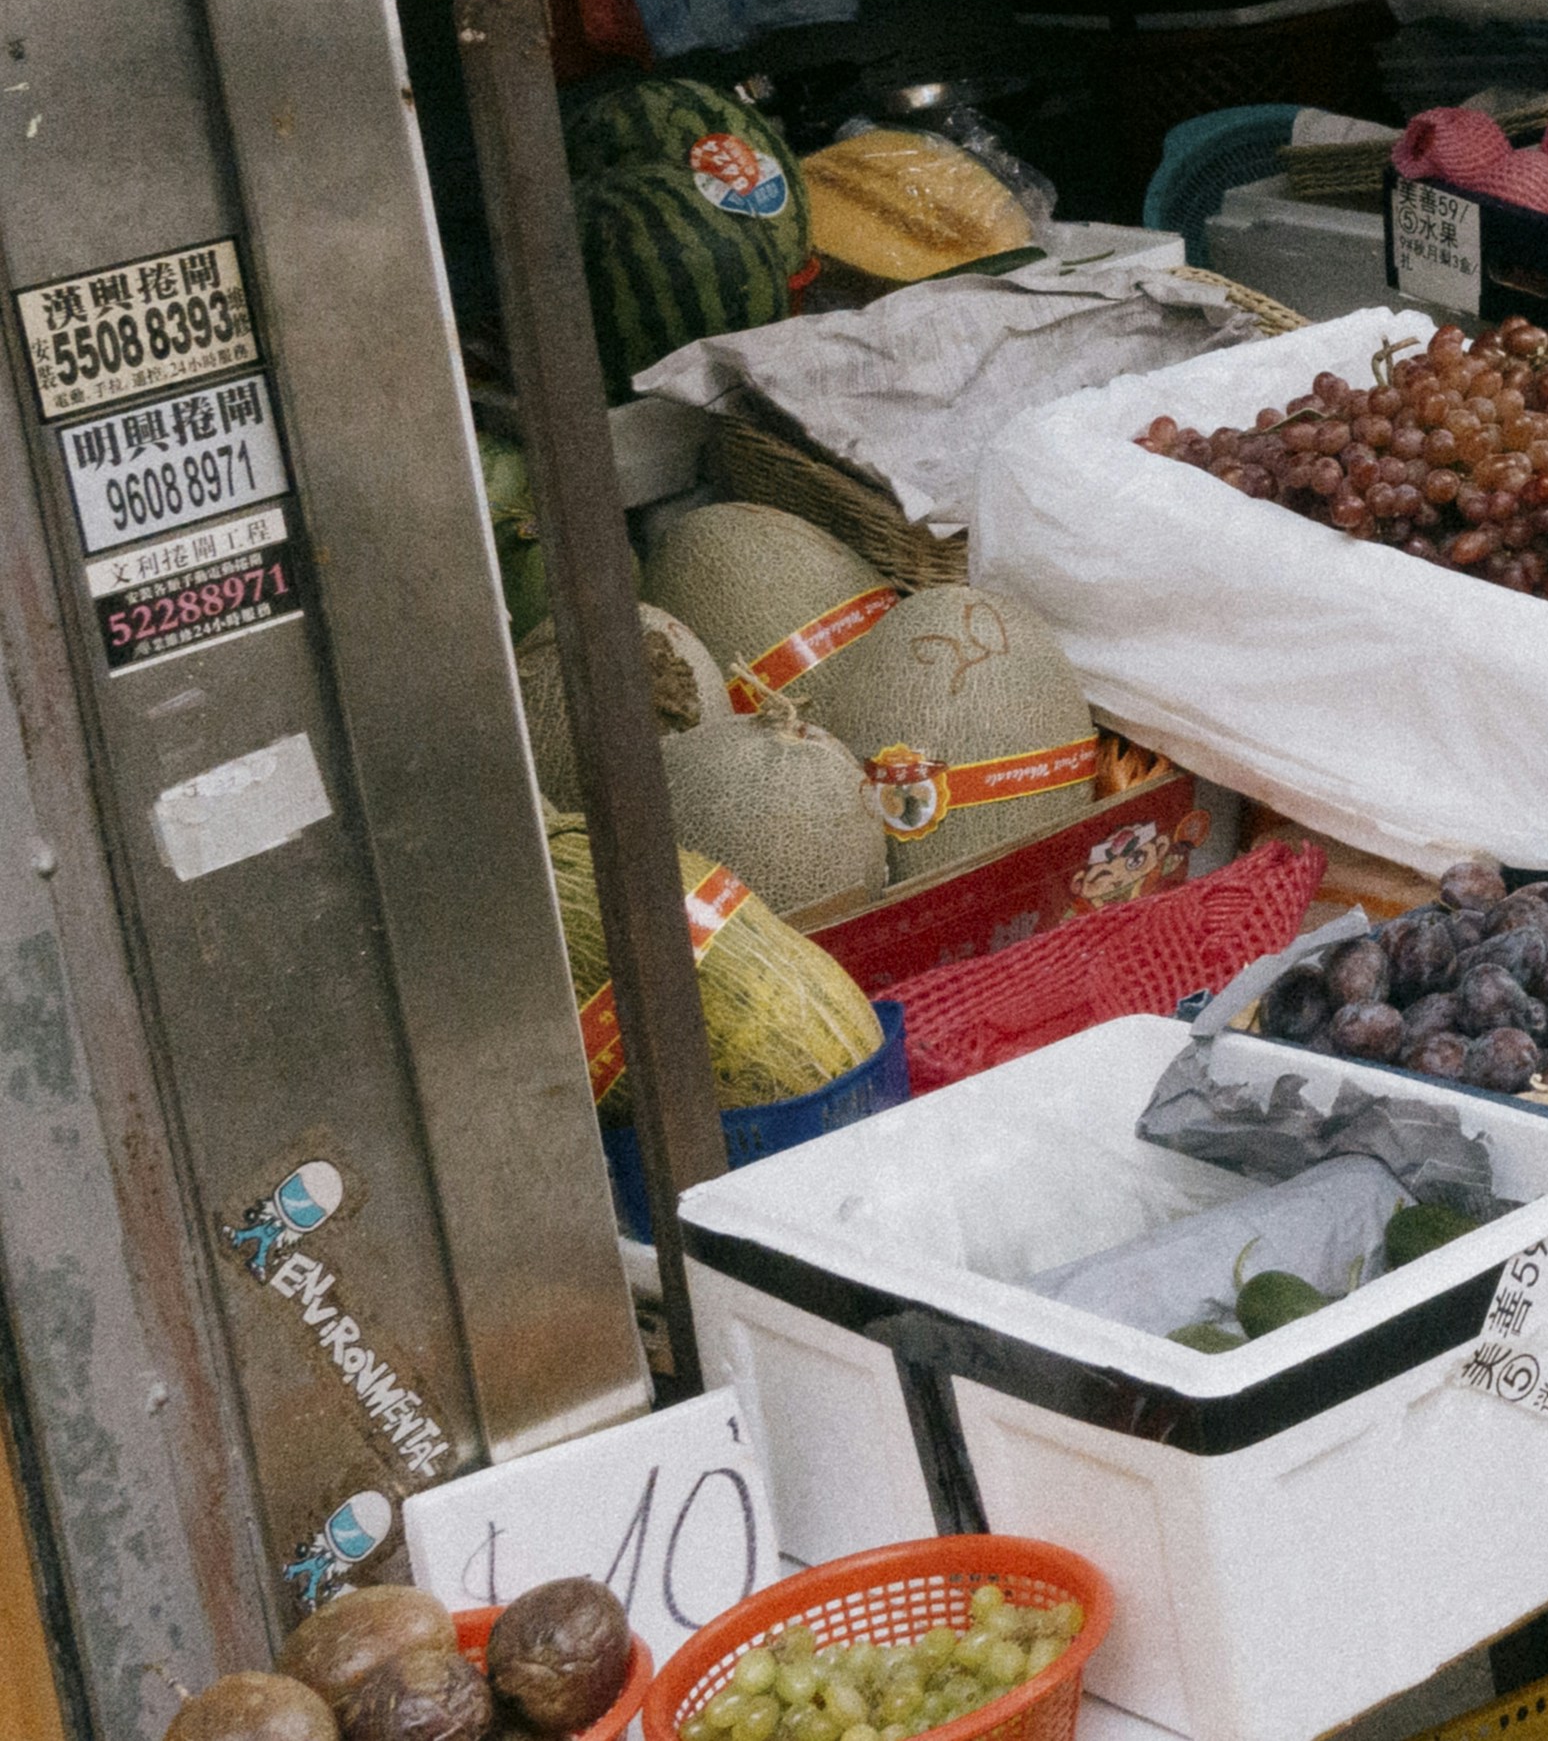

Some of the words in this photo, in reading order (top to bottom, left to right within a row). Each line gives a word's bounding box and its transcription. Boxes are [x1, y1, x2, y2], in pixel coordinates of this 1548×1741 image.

[42, 249, 220, 330] 漢興捲閘
[54, 311, 144, 386] 5508
[149, 289, 229, 361] 8393
[73, 380, 264, 472] 明興捲閘
[106, 475, 183, 532] 9608
[185, 446, 257, 508] 8971
[109, 562, 290, 647] 52288971
[982, 763, 1050, 788] Wholesale
[270, 1253, 450, 1478] ENVIRONMENTAL
